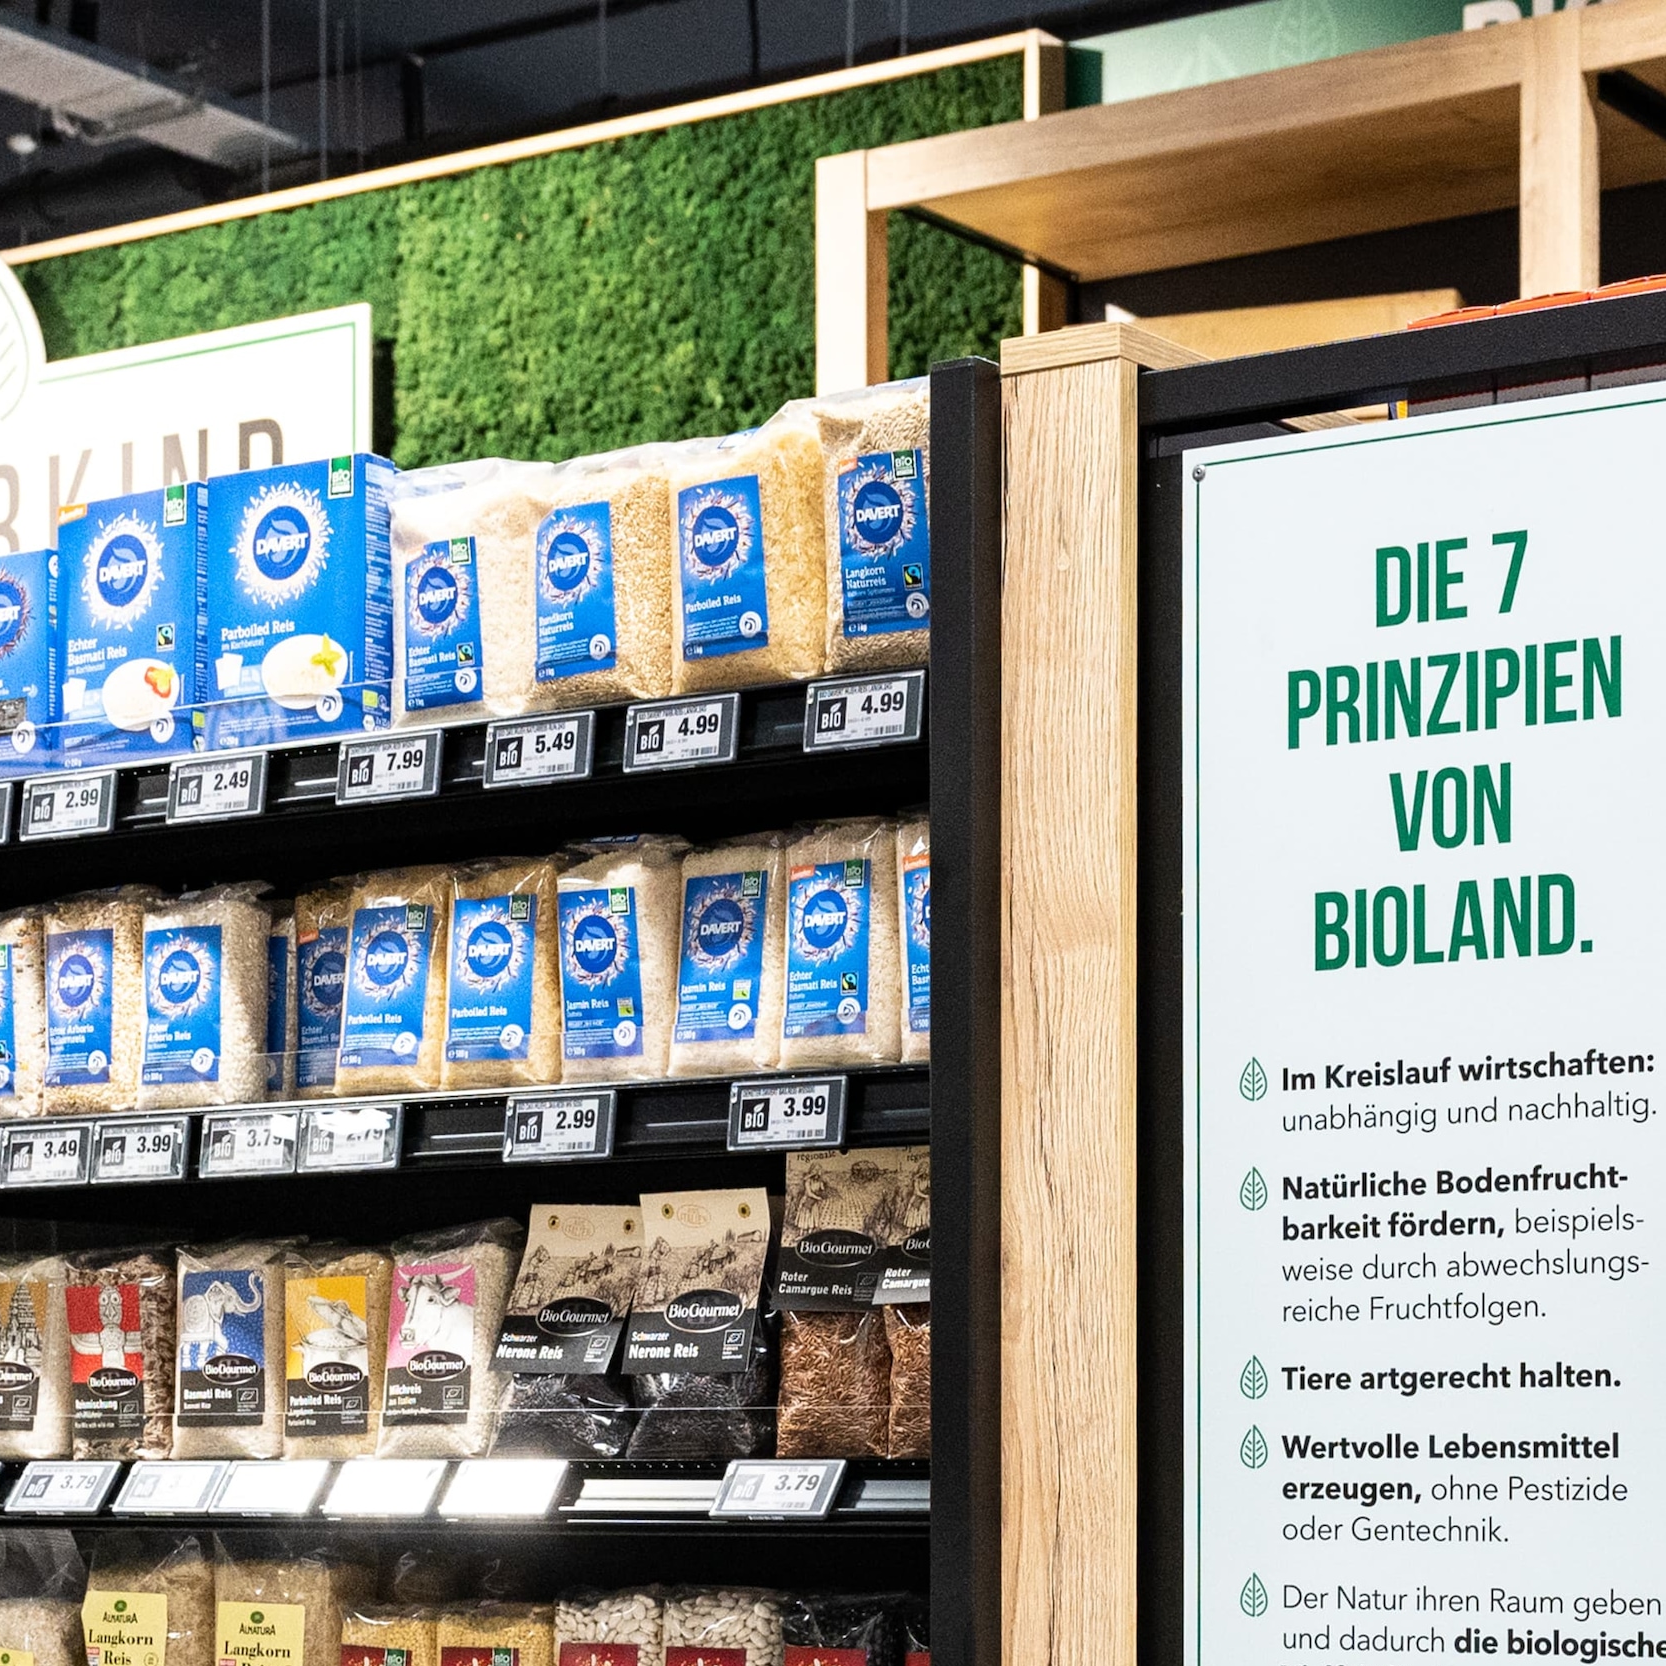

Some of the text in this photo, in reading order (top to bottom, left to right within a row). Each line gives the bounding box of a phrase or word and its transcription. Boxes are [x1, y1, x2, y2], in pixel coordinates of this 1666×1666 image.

[855, 504, 901, 522] DAVERT
[256, 532, 310, 557] DAVERT
[845, 567, 885, 580] Langkorn
[845, 575, 887, 589] Naturreis
[1375, 529, 1529, 628] DIE 7
[221, 620, 295, 641] Parboiled Reis
[68, 637, 98, 651] Echter
[68, 644, 127, 664] Basmati Reis
[860, 690, 905, 714] 4.99
[1287, 634, 1623, 751] PRINZIPIEN
[534, 732, 576, 754] 5.49
[386, 748, 424, 771] 7.99
[213, 769, 250, 792] 2.49
[1388, 761, 1512, 853] VON
[1314, 872, 1594, 972] BIOLAND.
[789, 970, 812, 982] Echter
[789, 978, 837, 994] Basmati Reis
[681, 981, 726, 996] Jasmin Reis
[1282, 1048, 1655, 1092] Im Kreislauf wirtschaften:
[782, 1096, 827, 1118] 3.99
[1282, 1091, 1657, 1134] unabhängig und nachhaltig.
[555, 1108, 596, 1130] 2.99
[43, 1139, 78, 1159] 3.49
[136, 1133, 172, 1154] 3.99
[1282, 1163, 1629, 1201] Natürliche Bodenfrucht-
[1282, 1205, 1645, 1242] barkeit fördern, beispiels-
[800, 1241, 873, 1256] BioGourmet
[1281, 1247, 1650, 1282] weise durch abwechslungs-
[780, 1271, 808, 1282] Roter
[779, 1282, 853, 1297] Camargue Reis
[669, 1303, 741, 1319] BioGourmet
[1283, 1293, 1547, 1327] reiche Fruchtfolgen.
[632, 1331, 670, 1342] Schwarzer
[630, 1344, 699, 1359] Nerone Reis
[204, 1364, 257, 1377] BioGourmet
[1281, 1362, 1622, 1397] Tiere artgerecht halten.
[1281, 1432, 1620, 1460] Wertvolle Lebensmittel
[774, 1473, 821, 1494] 3.79
[1281, 1474, 1629, 1508] erzeugen, ohne Pestizide
[1281, 1515, 1509, 1543] oder Gentechnik.
[1282, 1585, 1662, 1622] Der Natur ihren Raum geben
[224, 1643, 291, 1658] Langkorn
[1282, 1625, 1331, 1651] und
[1338, 1626, 1446, 1653] dadurch
[1453, 1628, 1499, 1655] die
